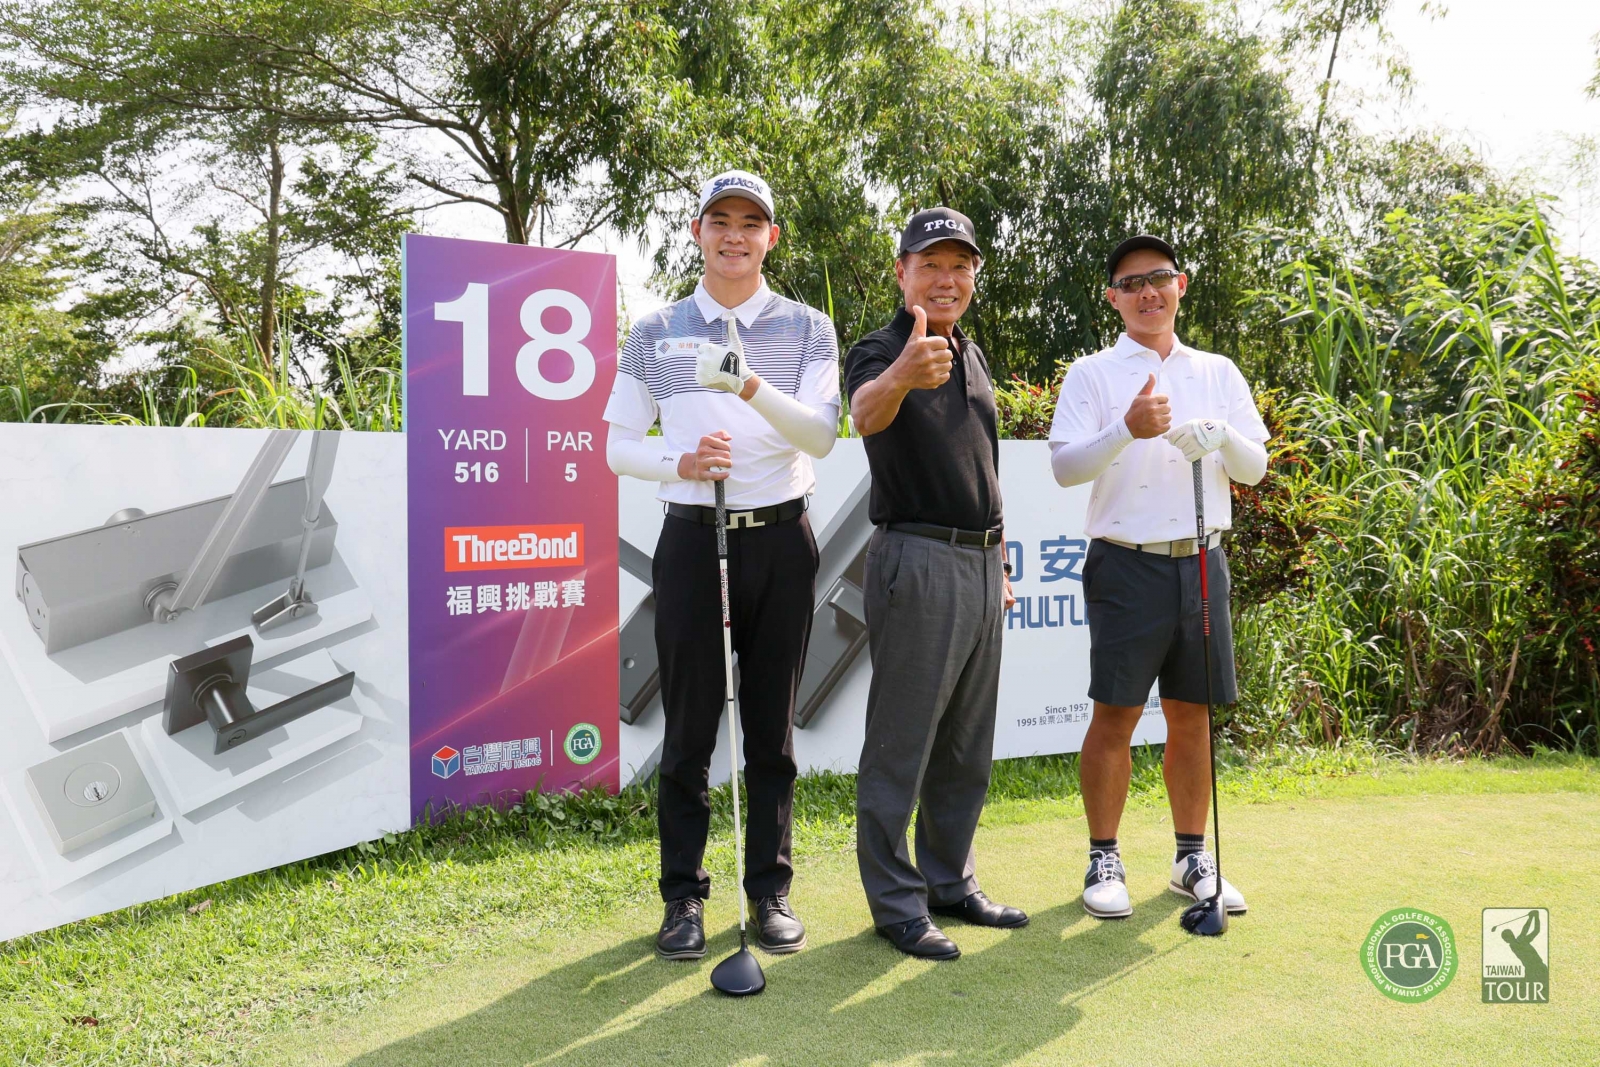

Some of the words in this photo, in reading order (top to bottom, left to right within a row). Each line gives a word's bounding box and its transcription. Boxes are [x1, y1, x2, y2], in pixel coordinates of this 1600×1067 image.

[710, 177, 763, 196] SRIXON
[924, 219, 967, 235] TPGA
[434, 282, 596, 401] 18
[438, 429, 507, 451] YARD
[547, 431, 594, 451] PAR
[454, 462, 499, 483] 516
[564, 463, 578, 482] 5
[452, 531, 577, 563] ThreeBond
[446, 579, 585, 616] 福興挑戰賽
[1004, 594, 1089, 630] AULTL
[1045, 706, 1067, 715] Since
[1069, 703, 1089, 712] 1957
[1017, 717, 1037, 727] 1995
[1039, 712, 1089, 726] 股票公開上市
[463, 737, 541, 767] 台灣福興
[573, 737, 594, 751] PGA
[463, 763, 498, 776] TAIWAN
[500, 760, 512, 771] FU
[514, 757, 542, 769] HSING
